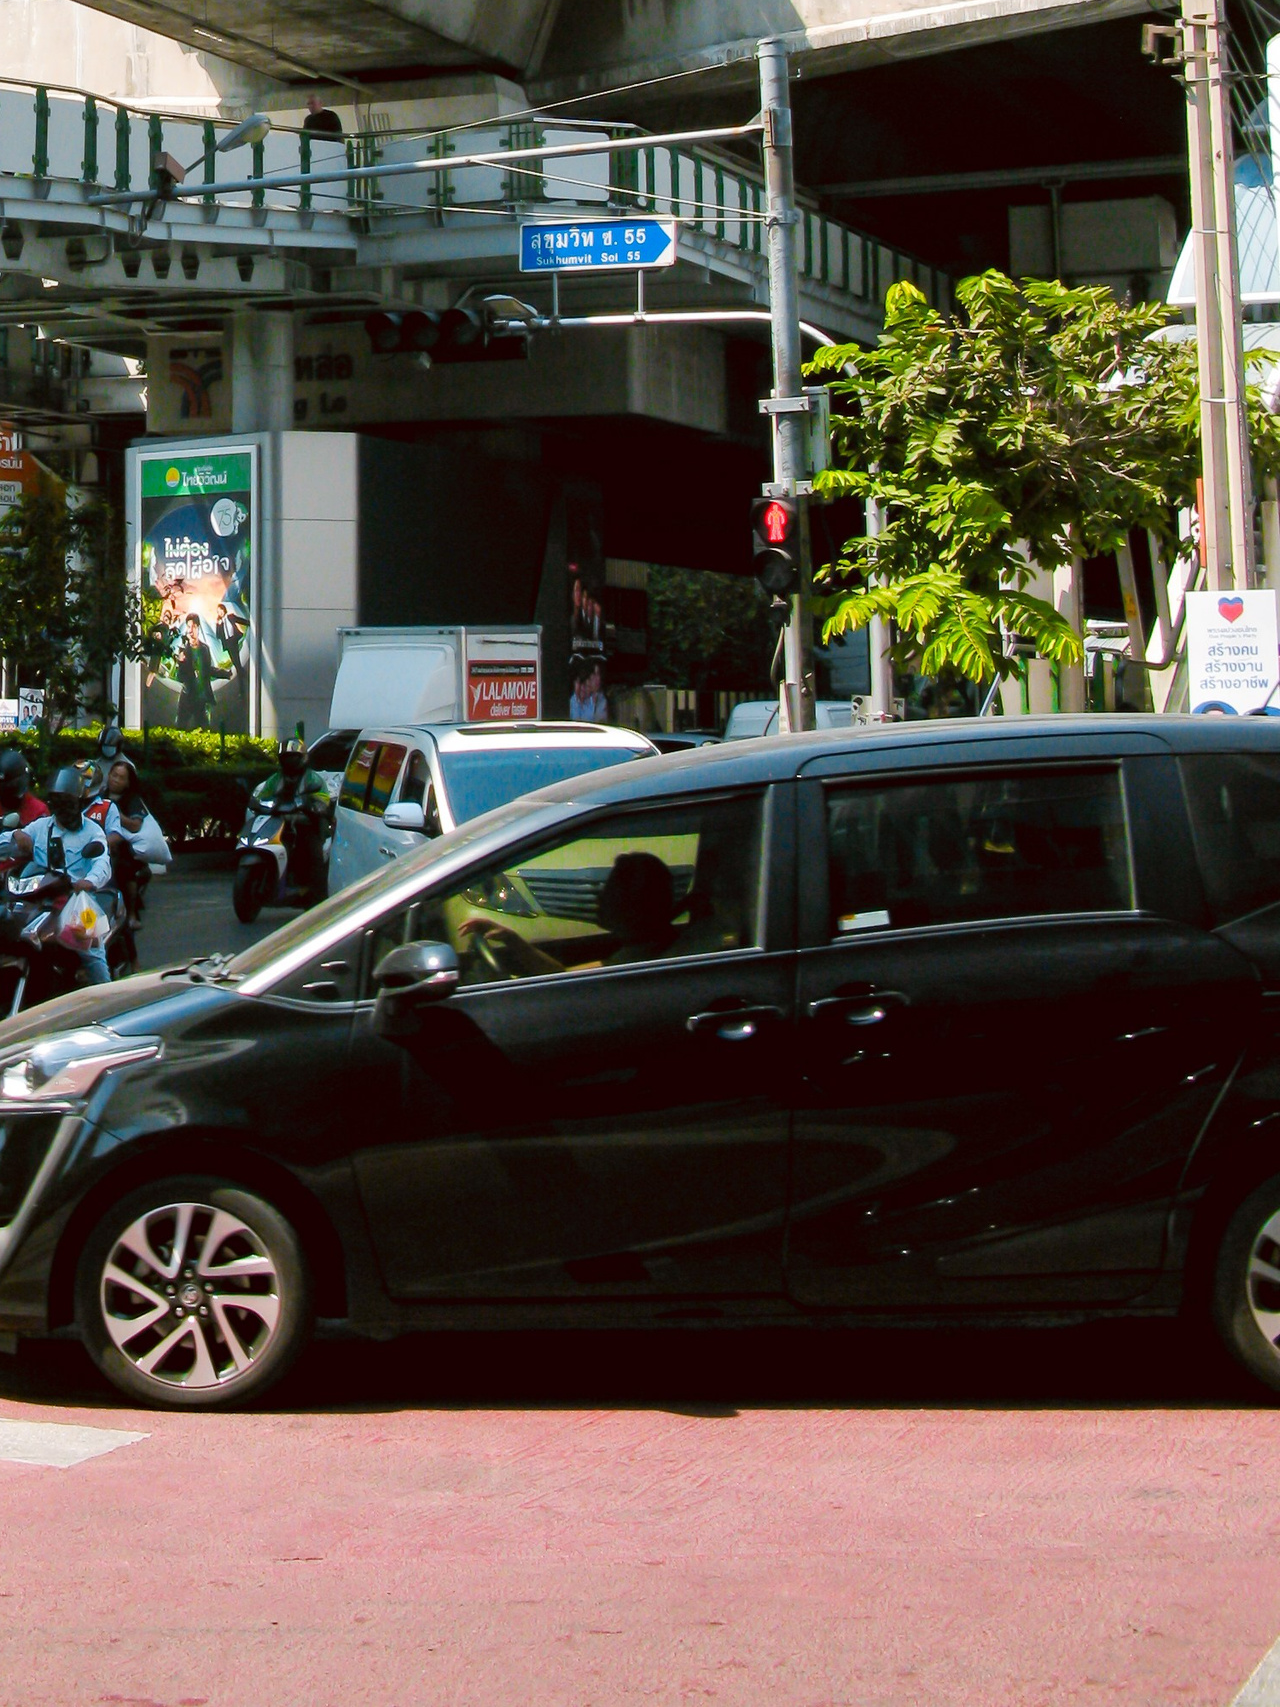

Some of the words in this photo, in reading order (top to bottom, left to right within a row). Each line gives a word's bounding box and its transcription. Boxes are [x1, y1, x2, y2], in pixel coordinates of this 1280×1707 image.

[531, 226, 594, 254] สุขุมวิท
[624, 228, 646, 244] 55
[536, 255, 592, 266] Sukhumvit
[601, 252, 618, 263] Soi
[627, 251, 640, 261] 55
[218, 508, 231, 526] 75
[164, 536, 209, 558] ไม่ต้อง
[1208, 643, 1258, 656] สร้างคน
[1205, 659, 1263, 673] สร้างงาน
[1200, 676, 1269, 689] สร้างอาชีพ
[483, 681, 536, 700] LALAMOVE
[490, 703, 510, 717] deliver
[512, 702, 528, 715] faster
